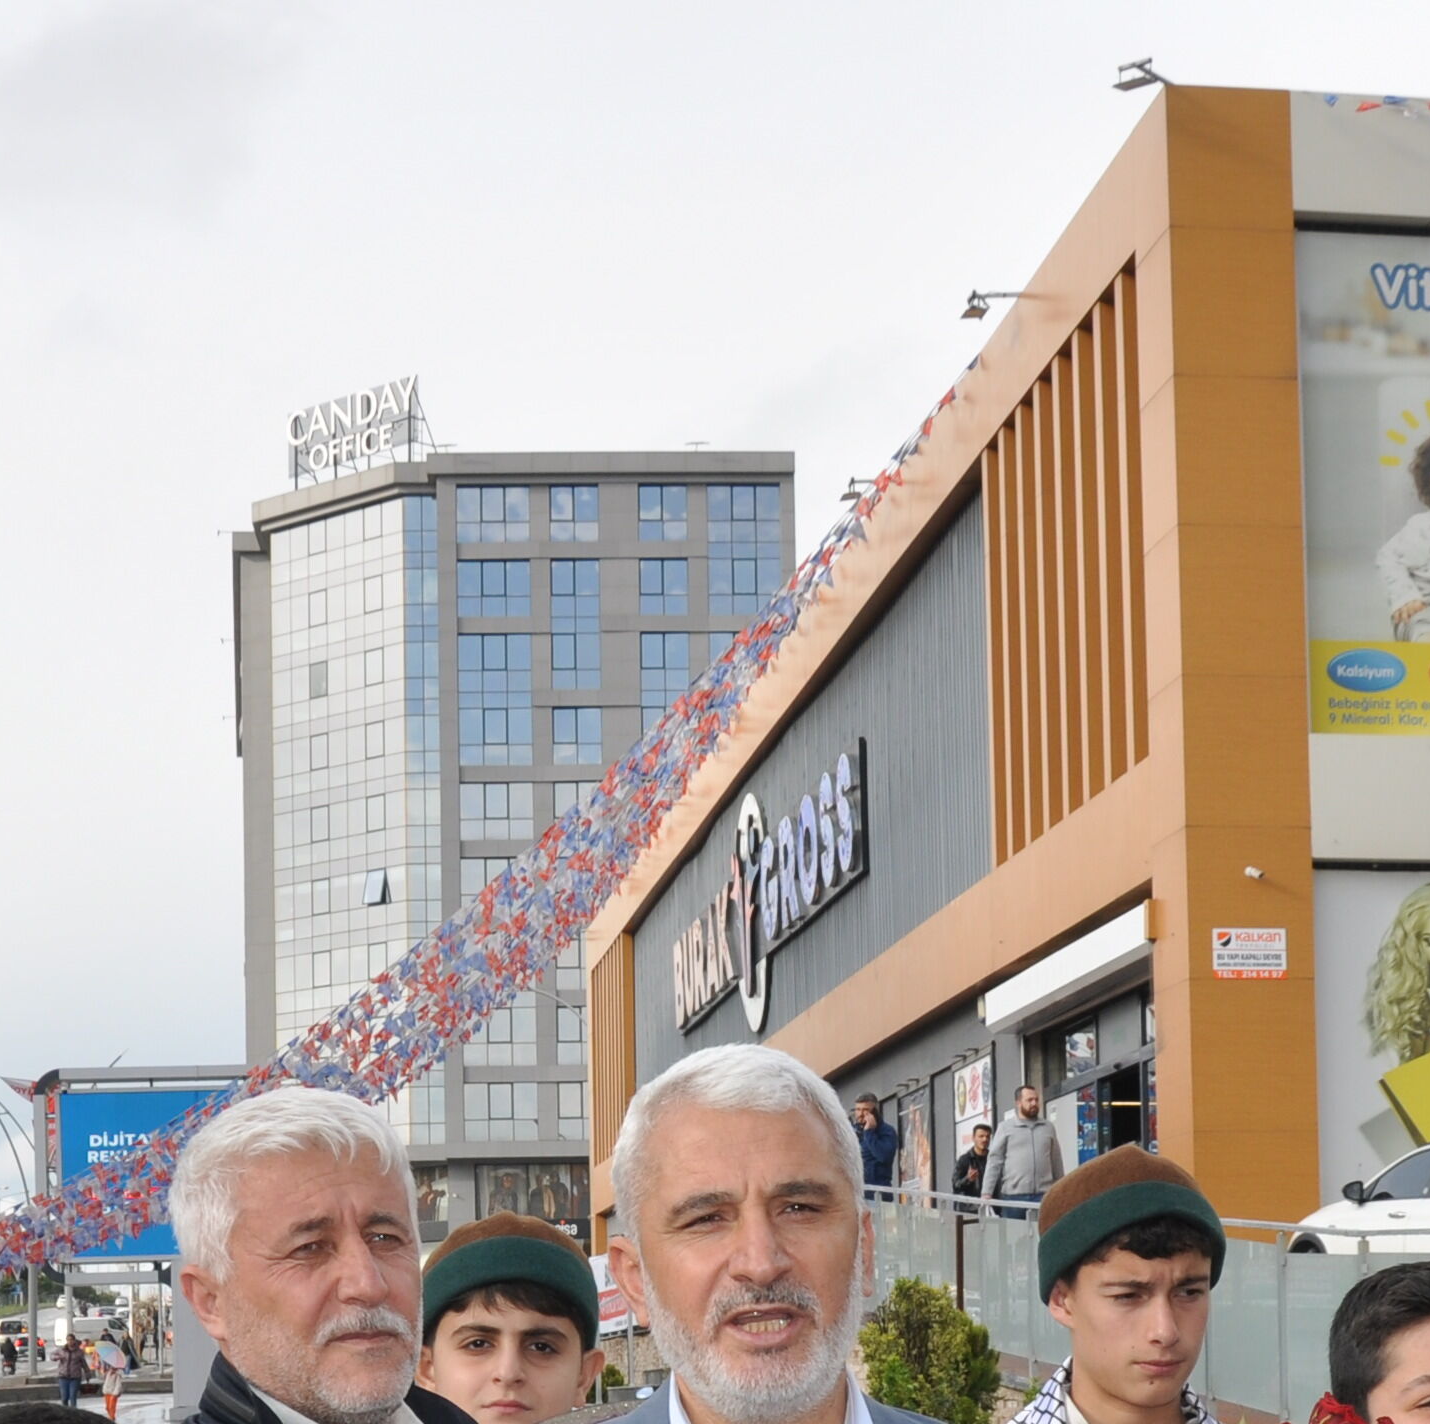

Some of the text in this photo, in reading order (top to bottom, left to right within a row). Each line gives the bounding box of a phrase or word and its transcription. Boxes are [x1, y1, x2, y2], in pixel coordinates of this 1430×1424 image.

[285, 374, 418, 448] CANDAY
[308, 422, 394, 471] OFFICE
[1337, 664, 1395, 680] Kalsiyum
[1328, 698, 1391, 712] Bebeğiniz
[673, 753, 853, 1030] BURAK GROSS
[89, 1131, 152, 1147] DİJİTA
